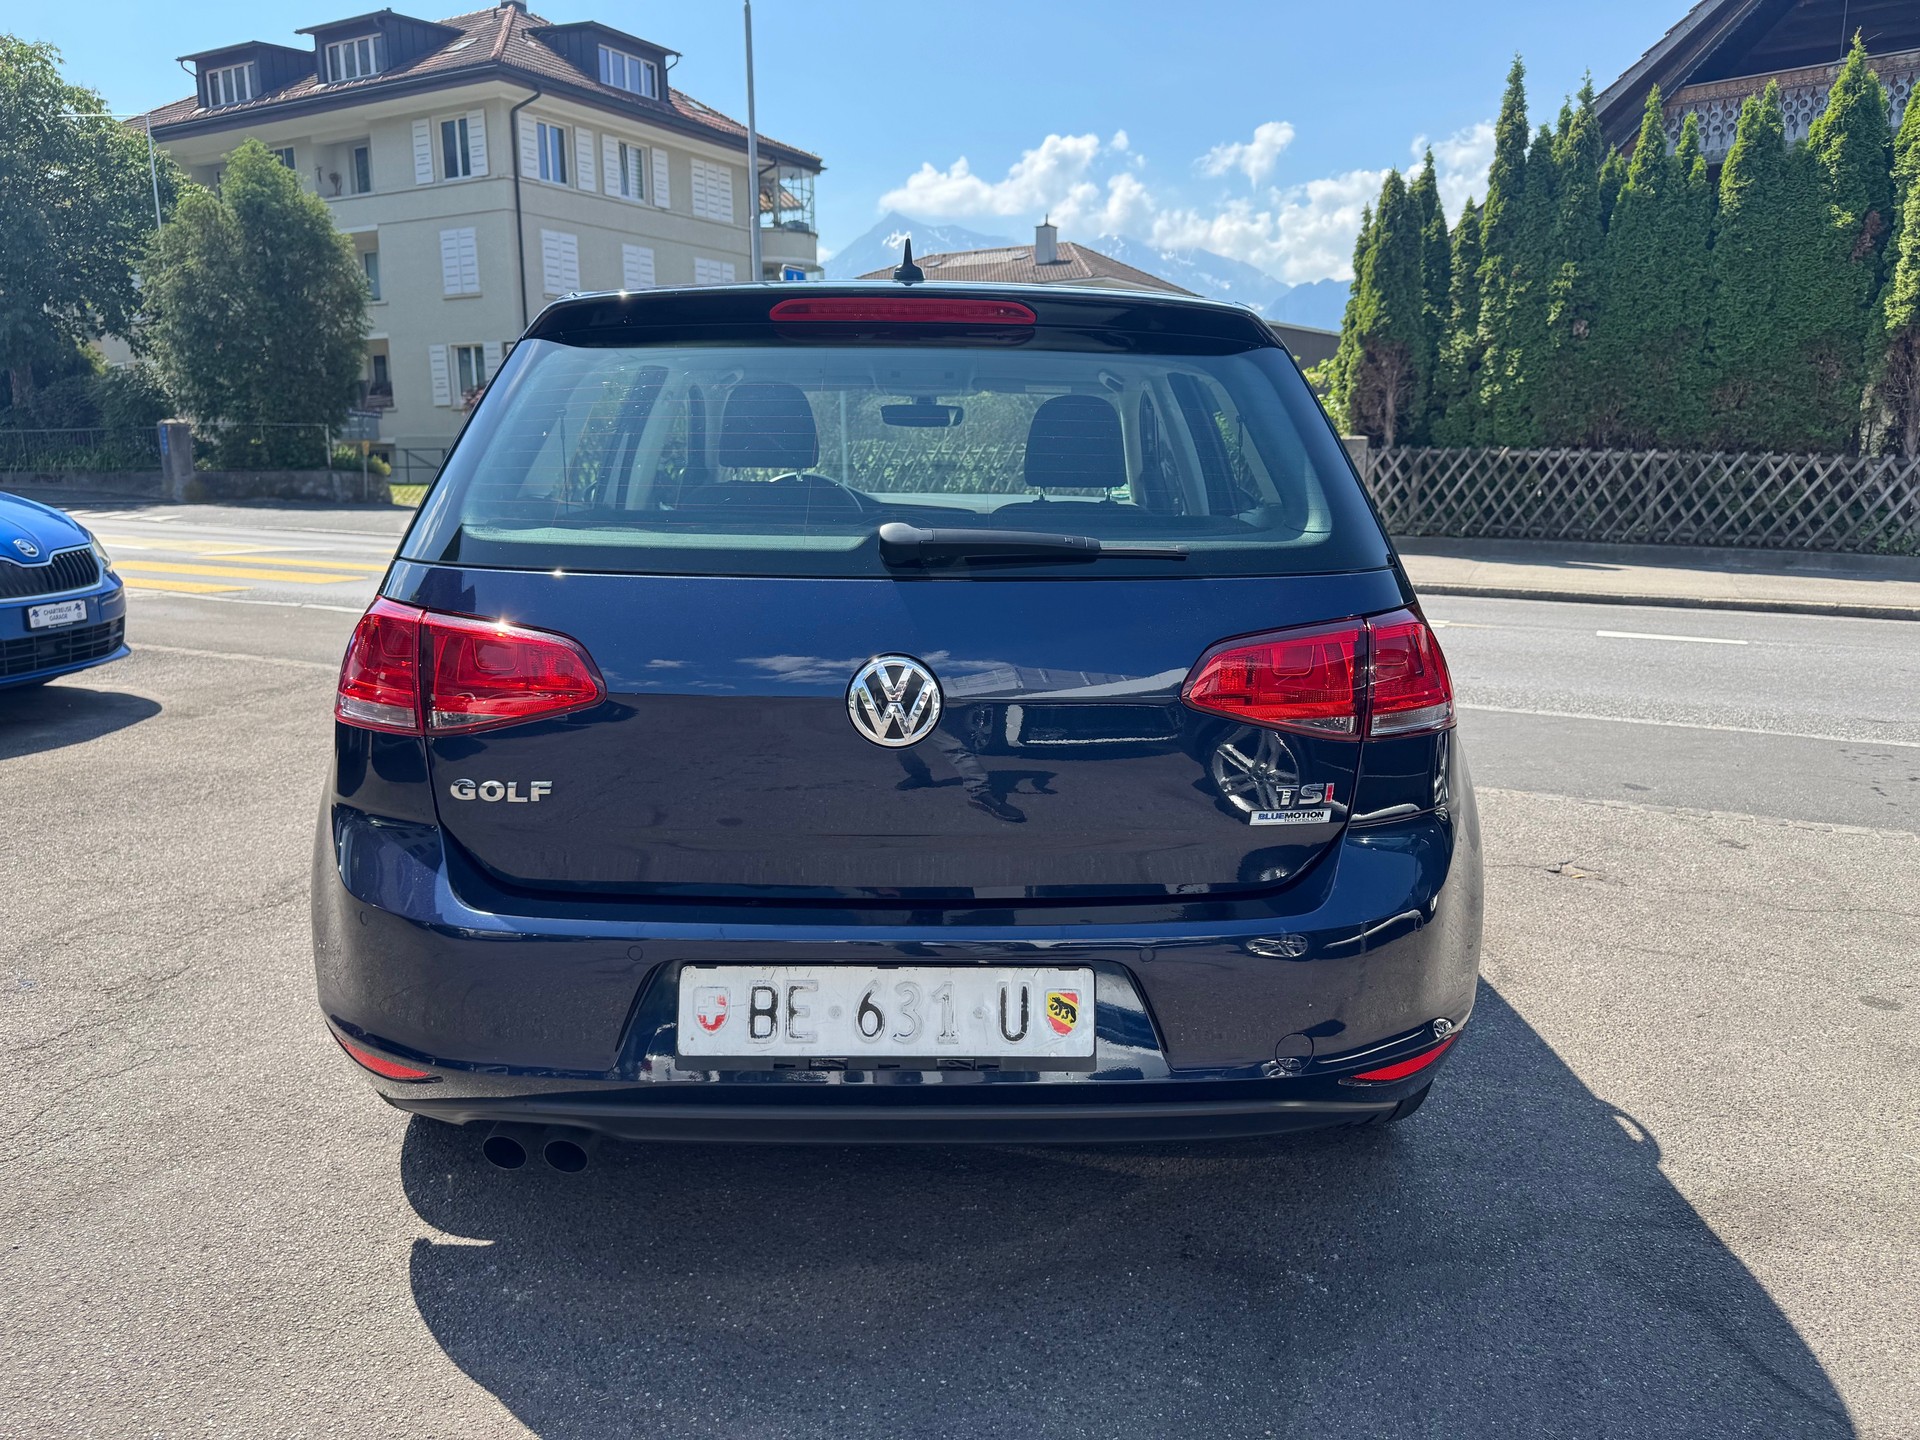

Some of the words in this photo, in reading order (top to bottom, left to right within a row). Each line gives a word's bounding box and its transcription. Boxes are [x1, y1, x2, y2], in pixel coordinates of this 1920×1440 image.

[49, 613, 68, 621] GARAGE
[852, 658, 938, 744] VW
[450, 778, 553, 803] GOLF
[1258, 811, 1324, 820] BLUEMOTION
[747, 980, 819, 1044] BE
[854, 980, 960, 1044] 631
[997, 981, 1032, 1042] U
